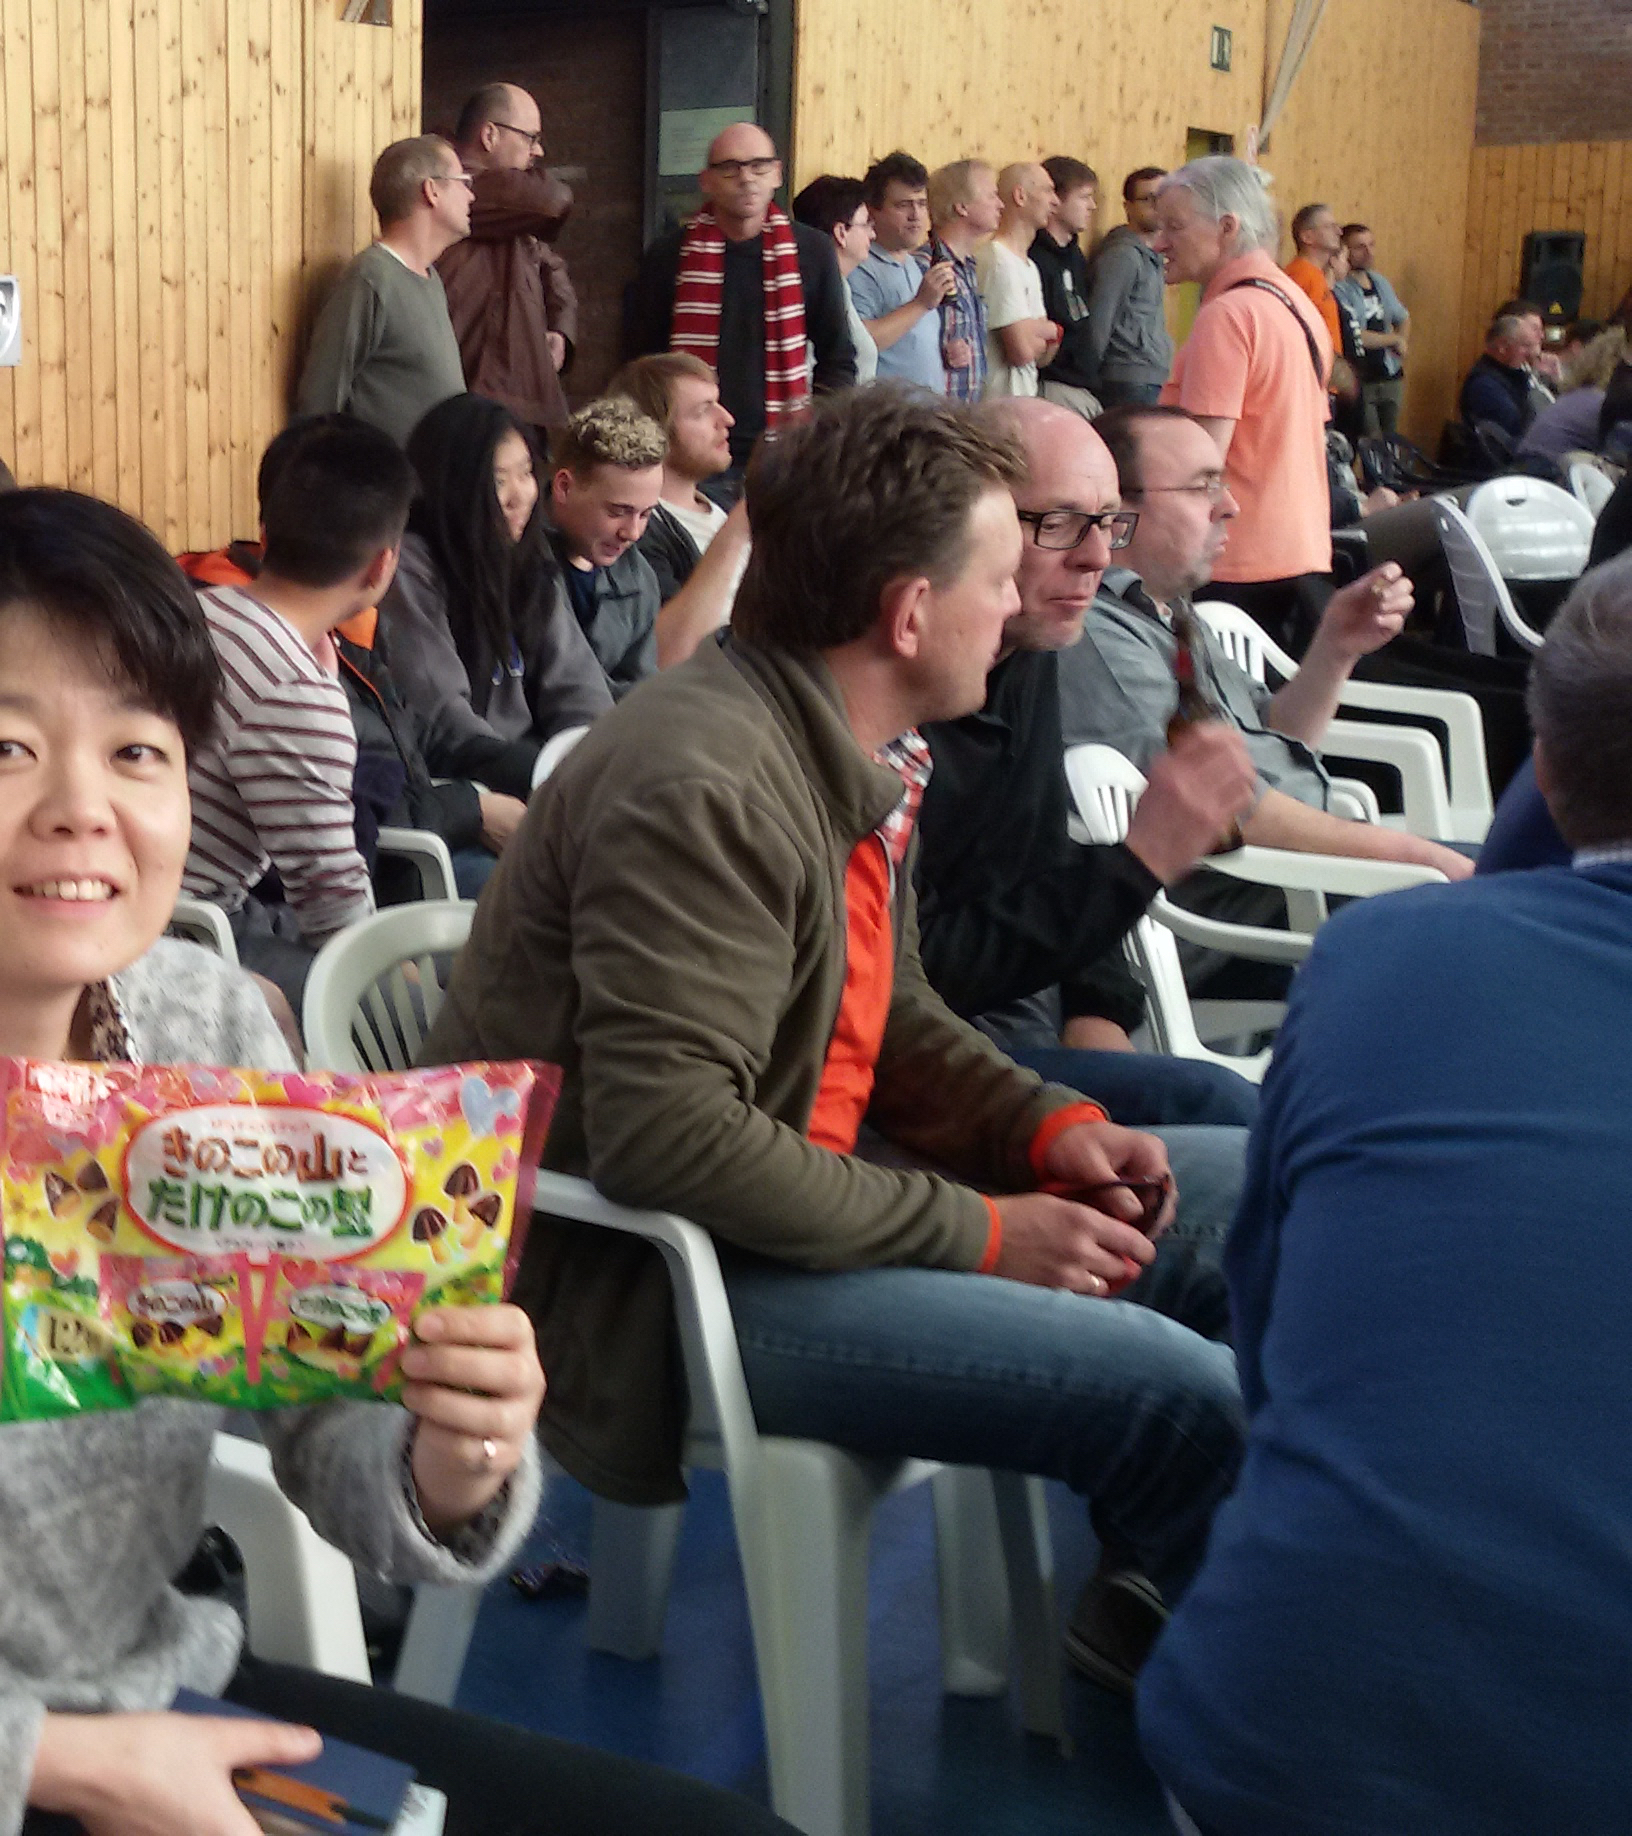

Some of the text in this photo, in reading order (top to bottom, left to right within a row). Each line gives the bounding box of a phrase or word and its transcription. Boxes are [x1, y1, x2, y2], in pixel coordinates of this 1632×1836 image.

[162, 1124, 369, 1184] きのこの山と
